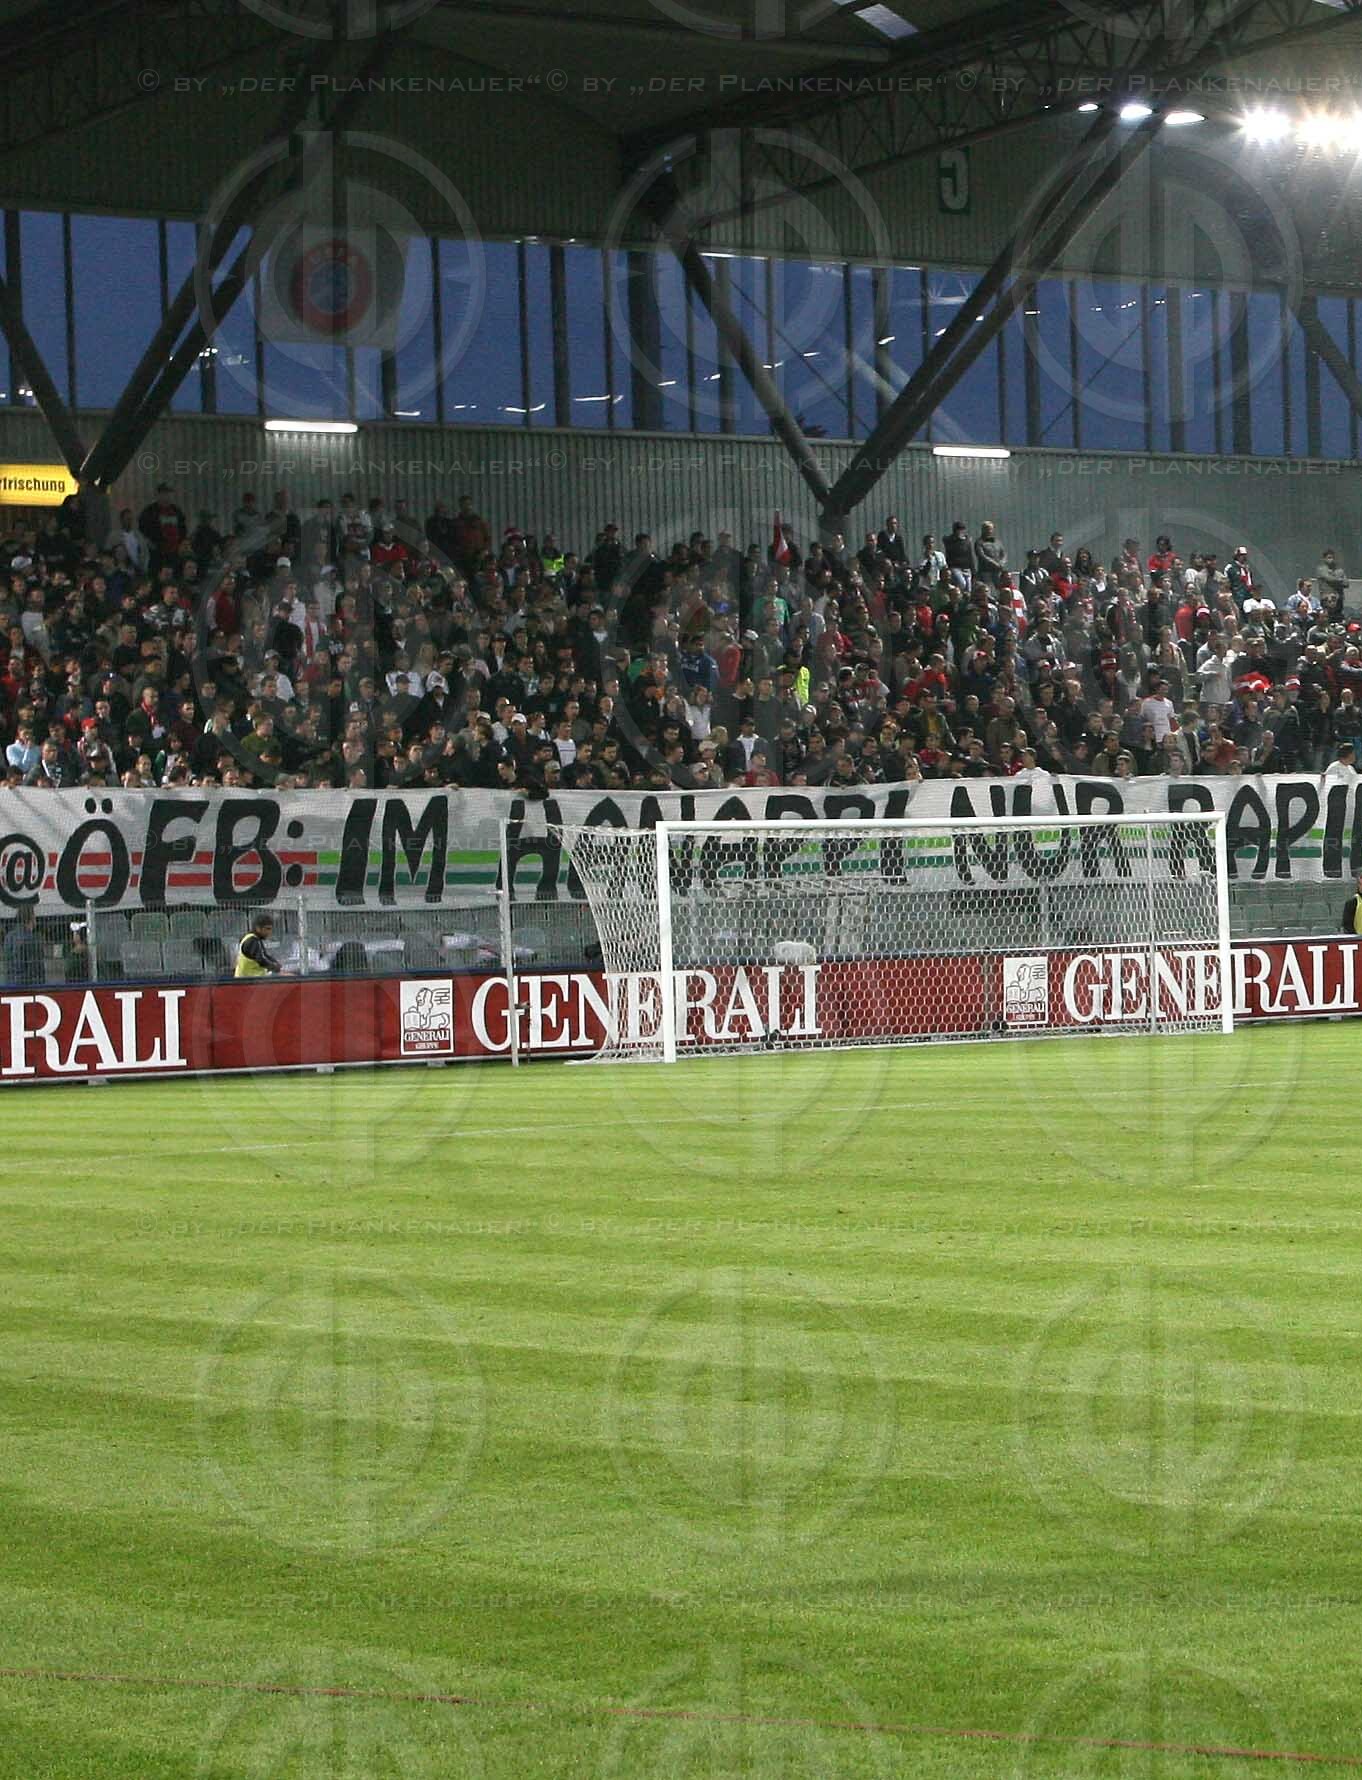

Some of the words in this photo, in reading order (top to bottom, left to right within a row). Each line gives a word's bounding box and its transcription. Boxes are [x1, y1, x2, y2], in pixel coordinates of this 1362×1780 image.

[335, 797, 449, 906] IM
[950, 782, 1132, 886] NUR
[472, 965, 822, 1051] GENERALI
[1063, 944, 1358, 1023] GENERALI
[0, 990, 188, 1076] RALI
[404, 1030, 450, 1041] GENERALI
